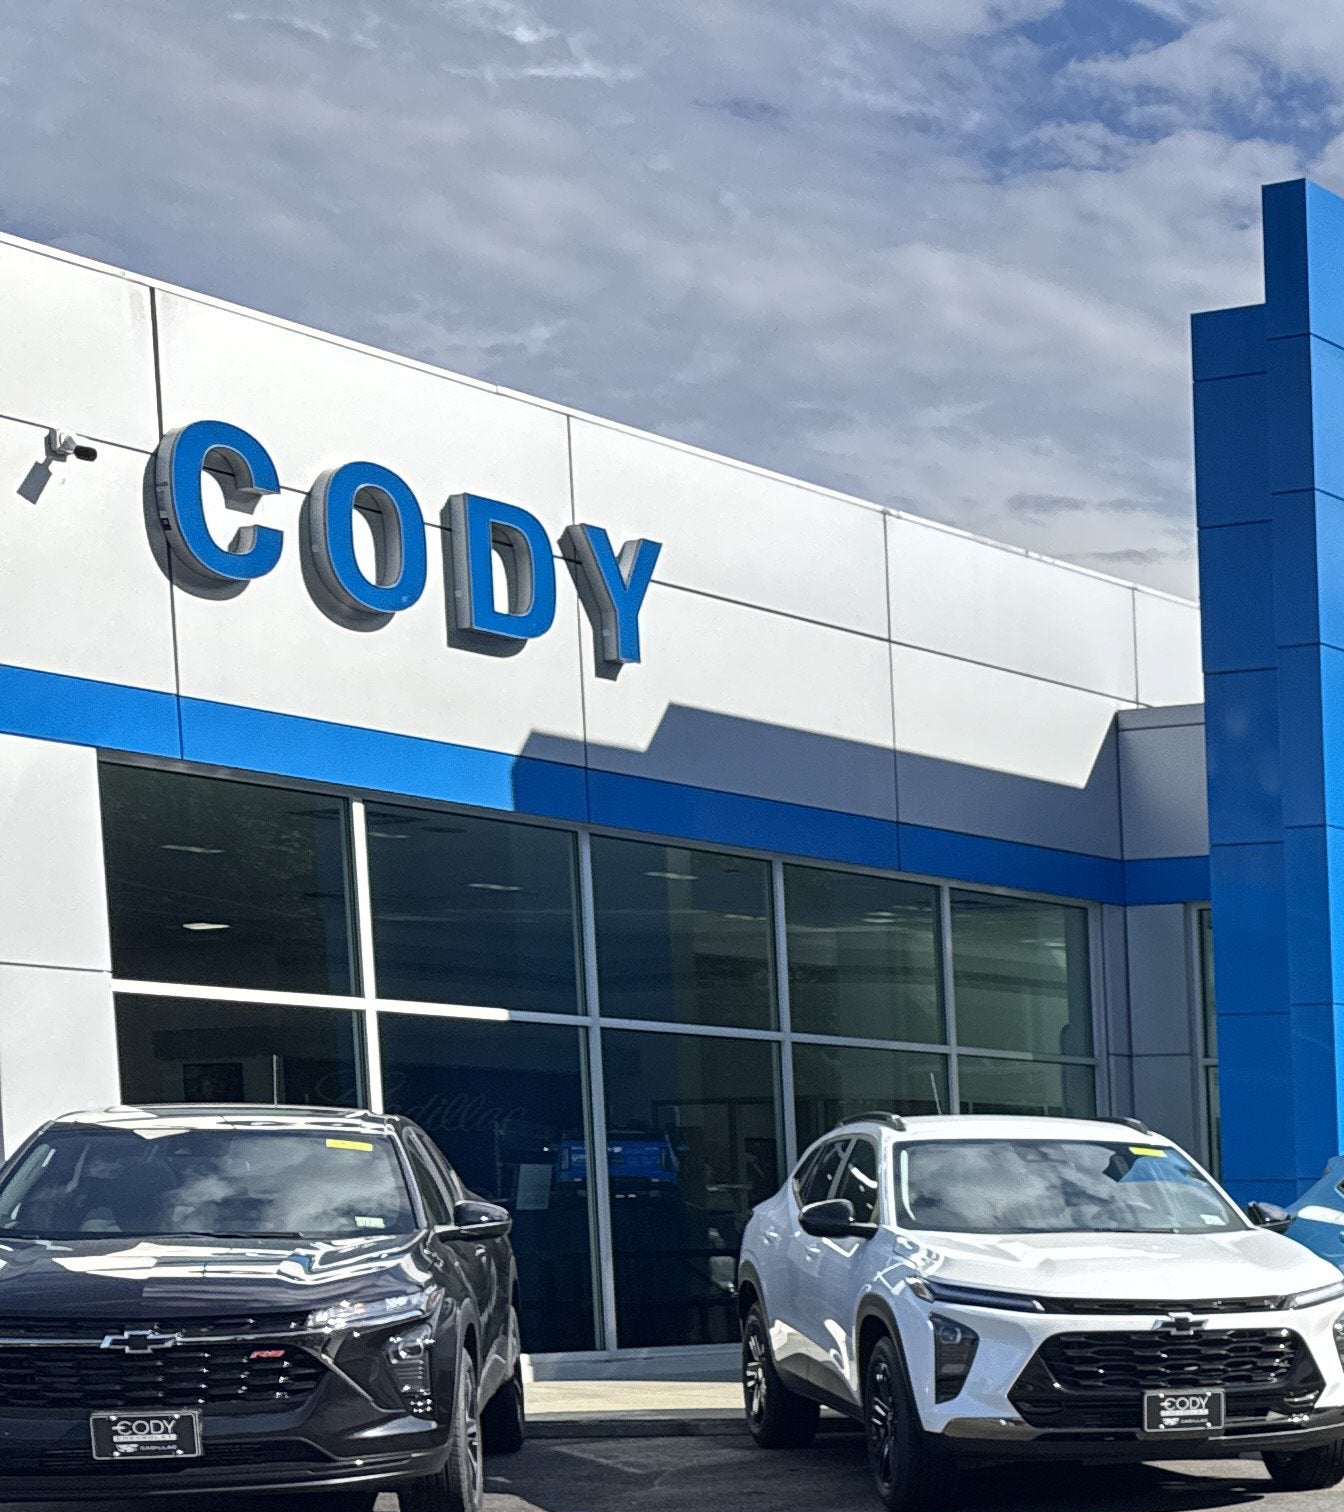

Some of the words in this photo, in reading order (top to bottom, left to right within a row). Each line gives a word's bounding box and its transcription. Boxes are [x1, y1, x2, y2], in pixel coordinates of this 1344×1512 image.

[150, 420, 662, 668] CODY
[1161, 1397, 1208, 1410] CODY
[113, 1420, 176, 1435] CODY
